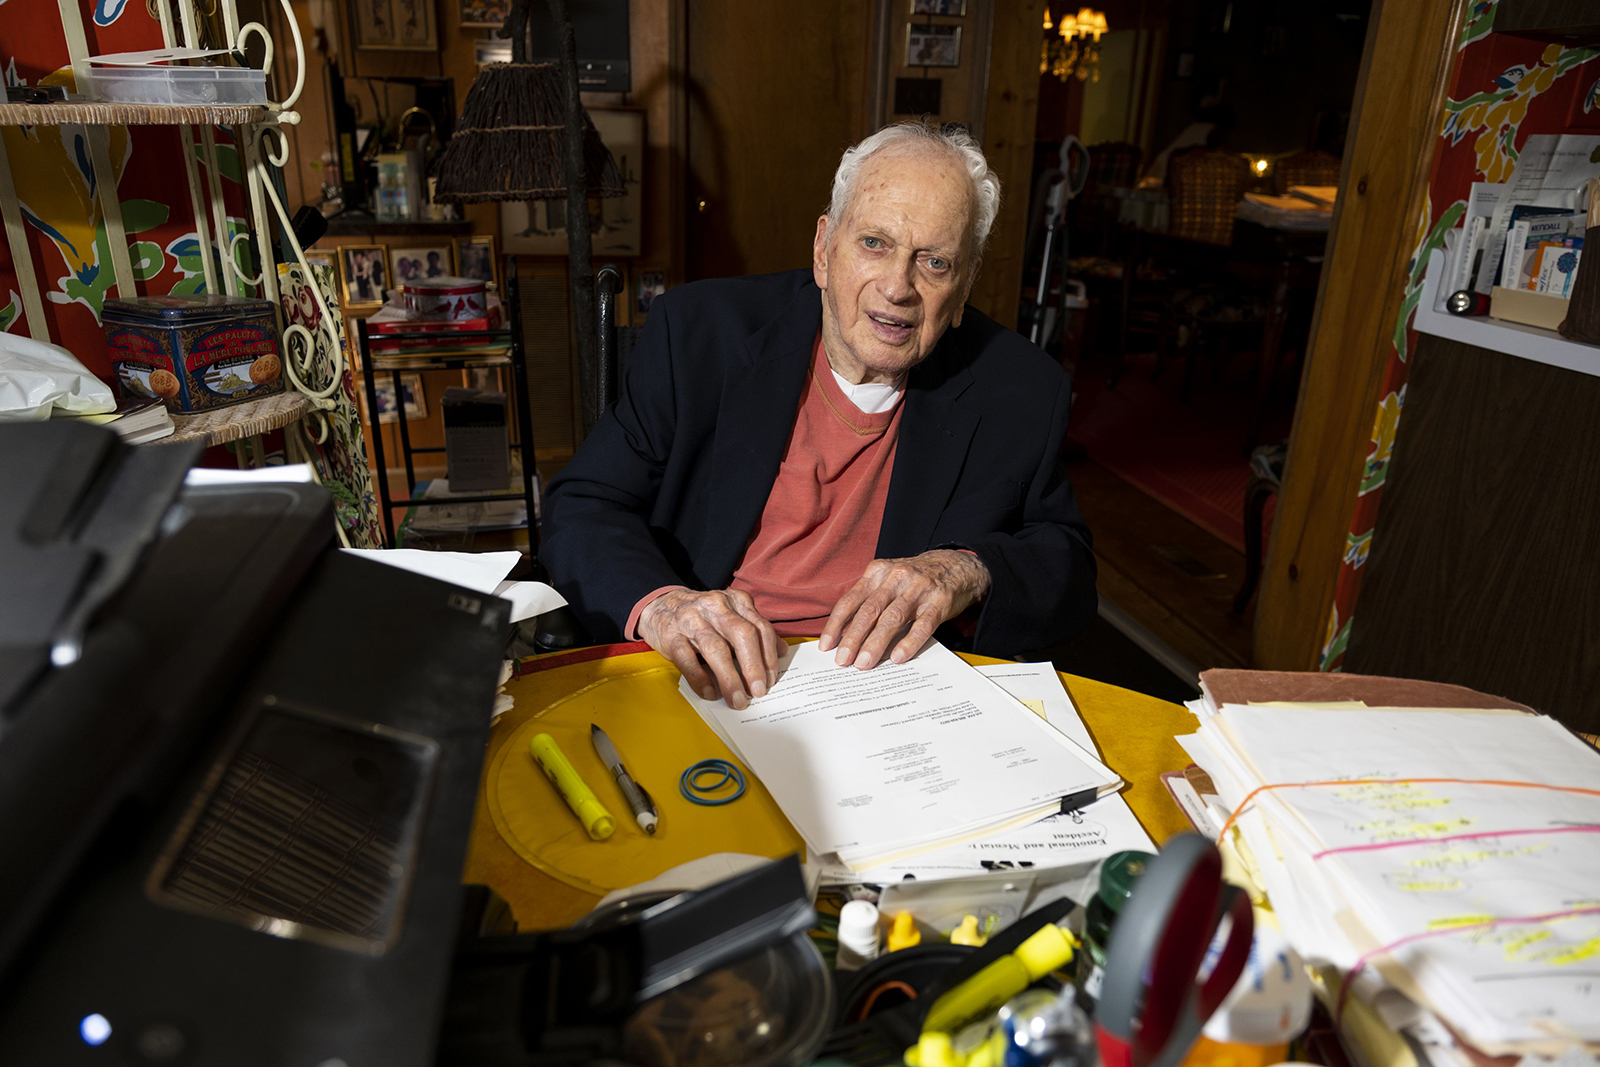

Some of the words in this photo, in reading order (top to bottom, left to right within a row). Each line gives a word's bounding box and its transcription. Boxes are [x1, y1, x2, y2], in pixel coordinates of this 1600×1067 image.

[1531, 223, 1561, 232] KENDALL
[207, 334, 225, 347] LES
[225, 330, 256, 341] PALETS
[192, 354, 208, 367] LA
[234, 341, 274, 358] POULARD
[1052, 830, 1101, 840] Accident
[1047, 838, 1107, 849] Emotional
